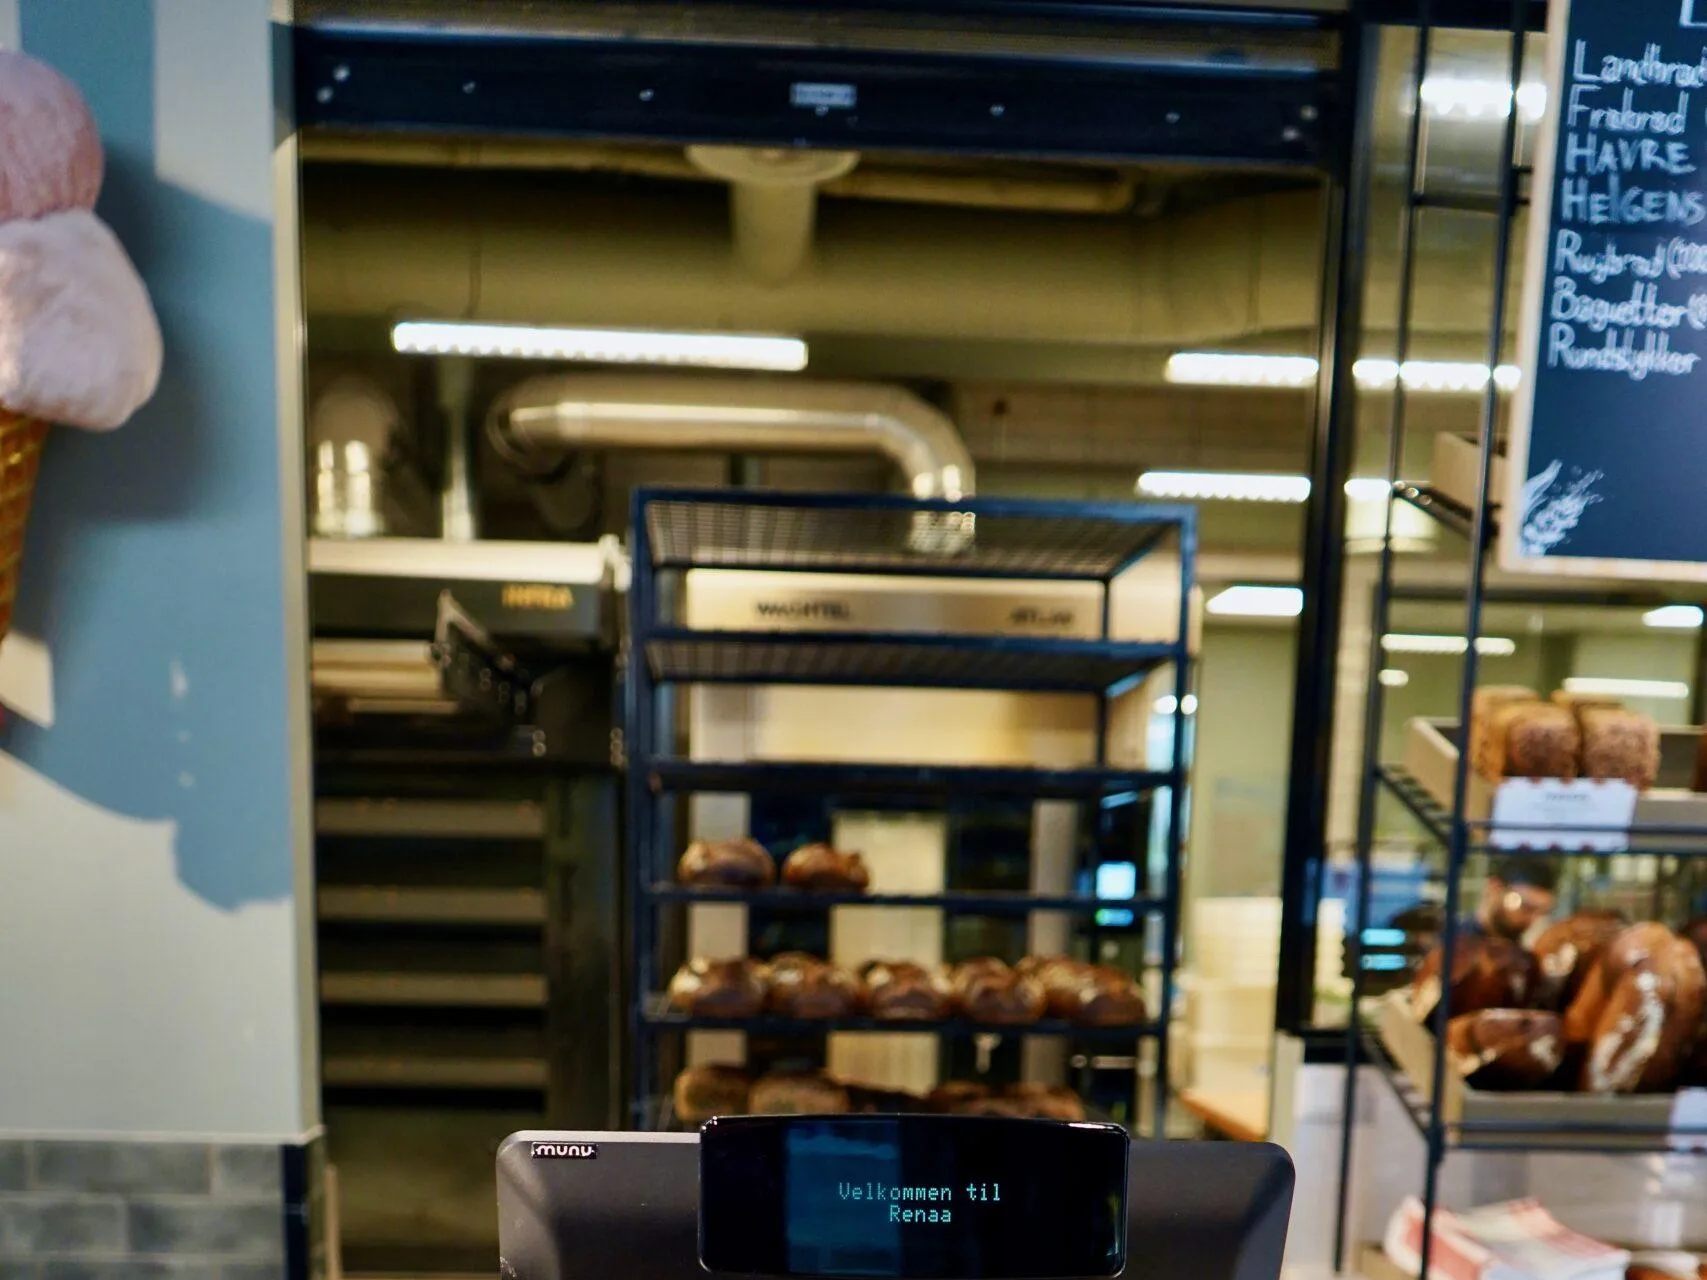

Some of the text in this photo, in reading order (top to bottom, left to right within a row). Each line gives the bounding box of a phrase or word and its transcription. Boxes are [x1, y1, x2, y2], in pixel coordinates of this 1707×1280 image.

[1565, 132, 1697, 174] HAVRE
[838, 1182, 1000, 1201] Velkommen til
[890, 1204, 951, 1223] Renaa
